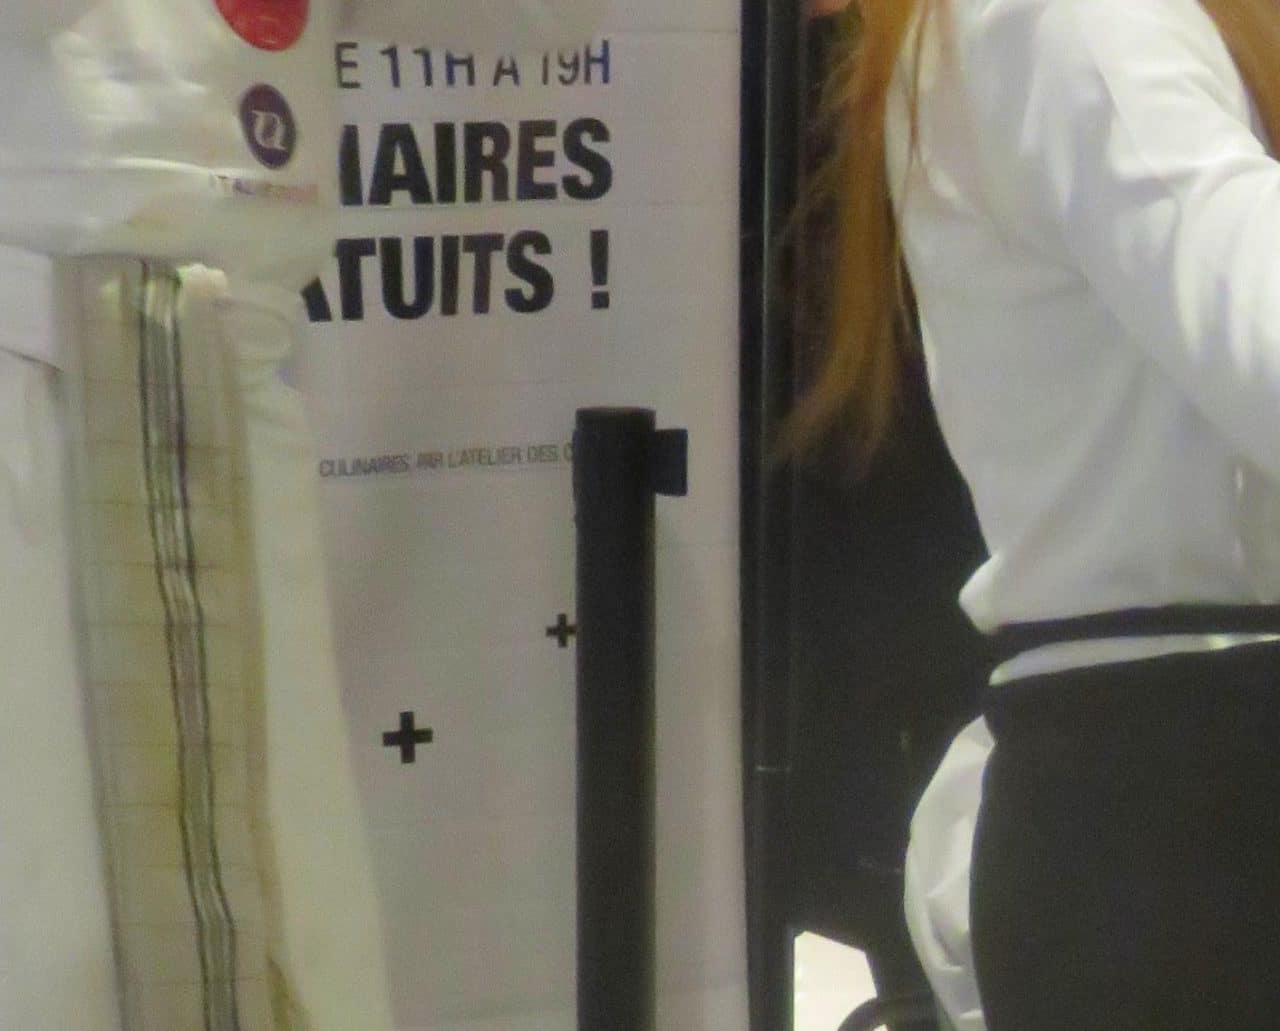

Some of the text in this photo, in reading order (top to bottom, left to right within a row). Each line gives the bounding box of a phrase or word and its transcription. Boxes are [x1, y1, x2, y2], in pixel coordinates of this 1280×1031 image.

[301, 230, 555, 323] TUITS
[318, 454, 409, 477] CULINAIRES
[447, 445, 522, 468] L'ATELIER
[527, 443, 559, 463] DES
